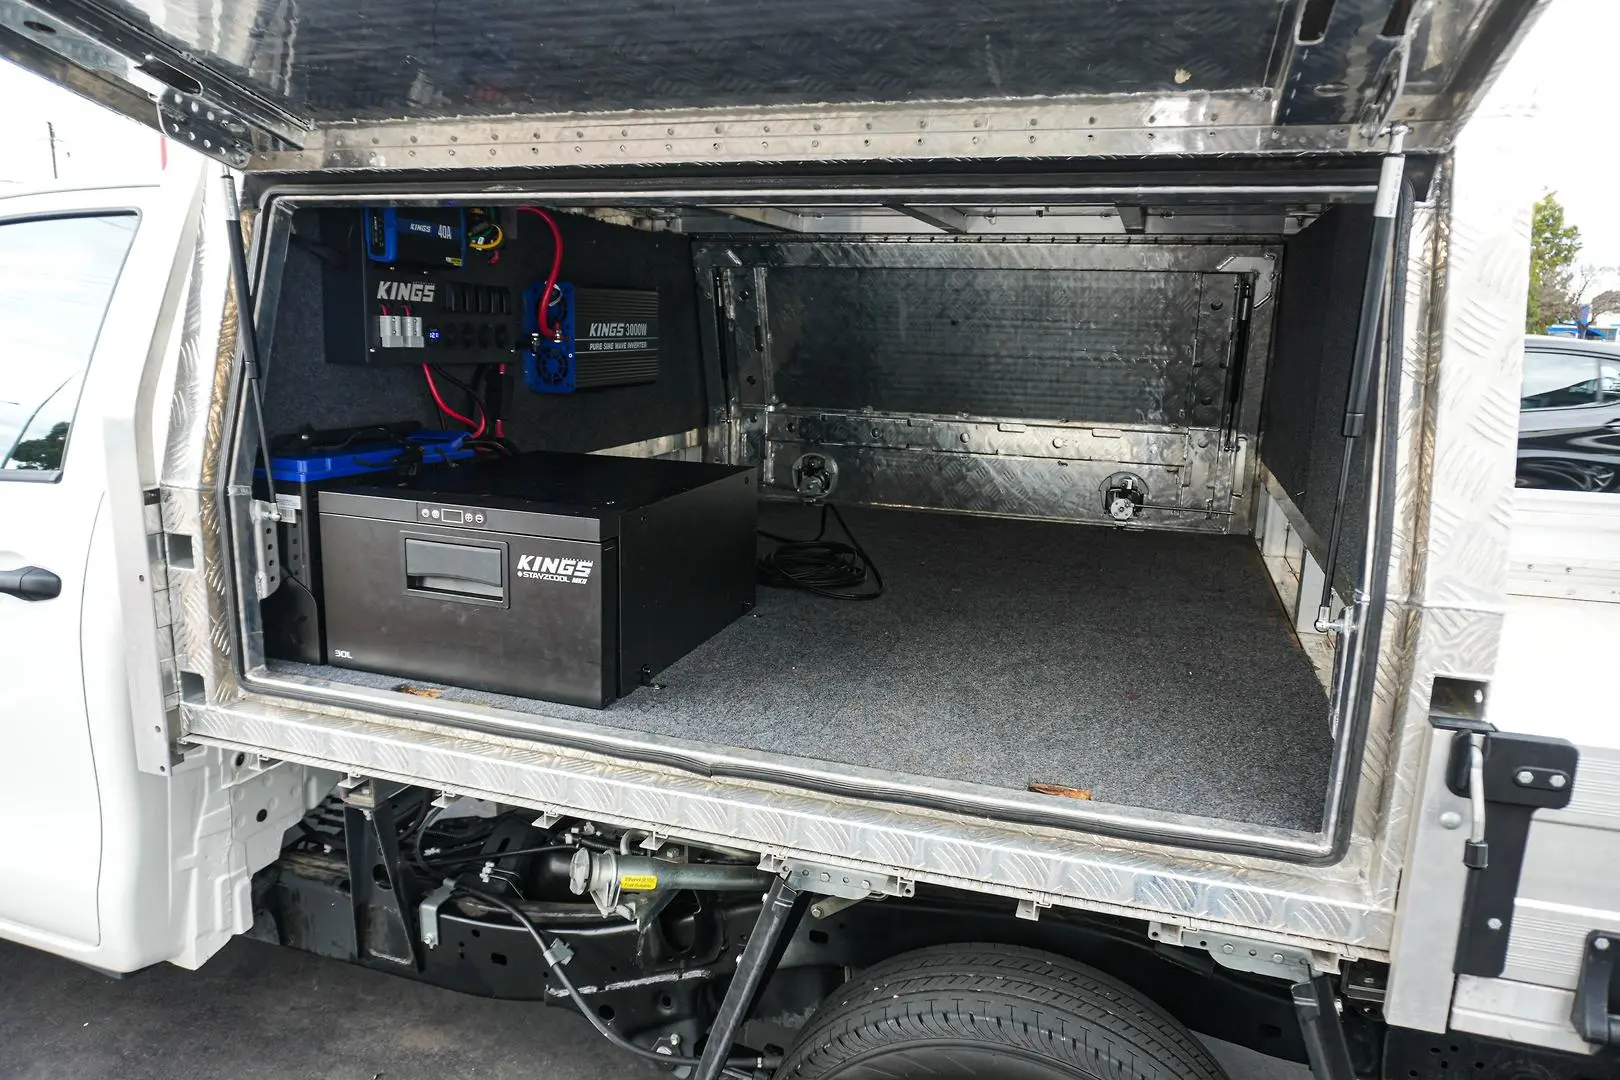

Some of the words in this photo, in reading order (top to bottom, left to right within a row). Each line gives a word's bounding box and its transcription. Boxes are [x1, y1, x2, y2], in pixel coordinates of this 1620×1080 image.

[410, 223, 431, 233] KINGS
[437, 225, 452, 240] 40A
[377, 281, 435, 302] KINGS
[589, 322, 624, 337] KINGS
[625, 323, 647, 336] 3000W
[627, 341, 647, 349] INVERTER
[517, 554, 594, 577] KINGS
[335, 649, 353, 659] 30L
